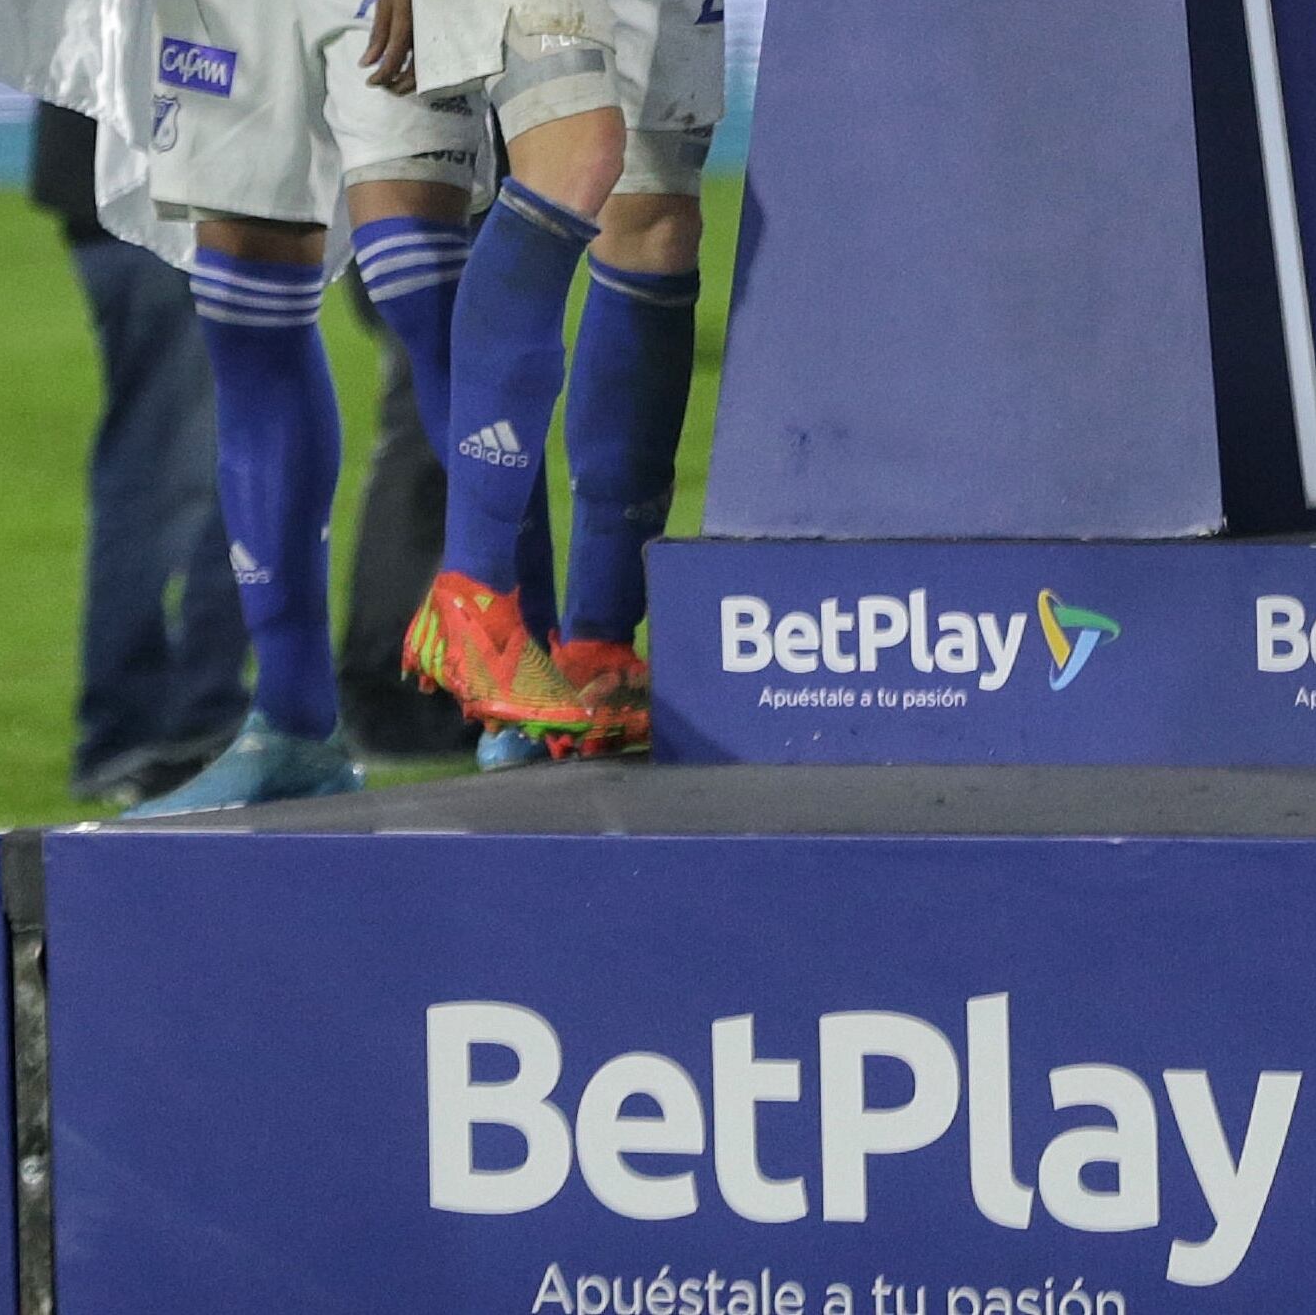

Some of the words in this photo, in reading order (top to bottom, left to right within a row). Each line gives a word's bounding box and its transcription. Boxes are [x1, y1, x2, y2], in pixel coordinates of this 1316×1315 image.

[458, 440, 529, 469] adidas
[721, 588, 1027, 690] BetPlay
[759, 687, 855, 710] Apuéstale
[860, 691, 872, 707] a
[877, 688, 898, 707] tu
[903, 687, 967, 711] pasión
[427, 992, 1302, 1286] BetPlay
[531, 1262, 806, 1315] Apuéstale
[823, 1282, 853, 1315] a
[871, 1274, 926, 1315] tu
